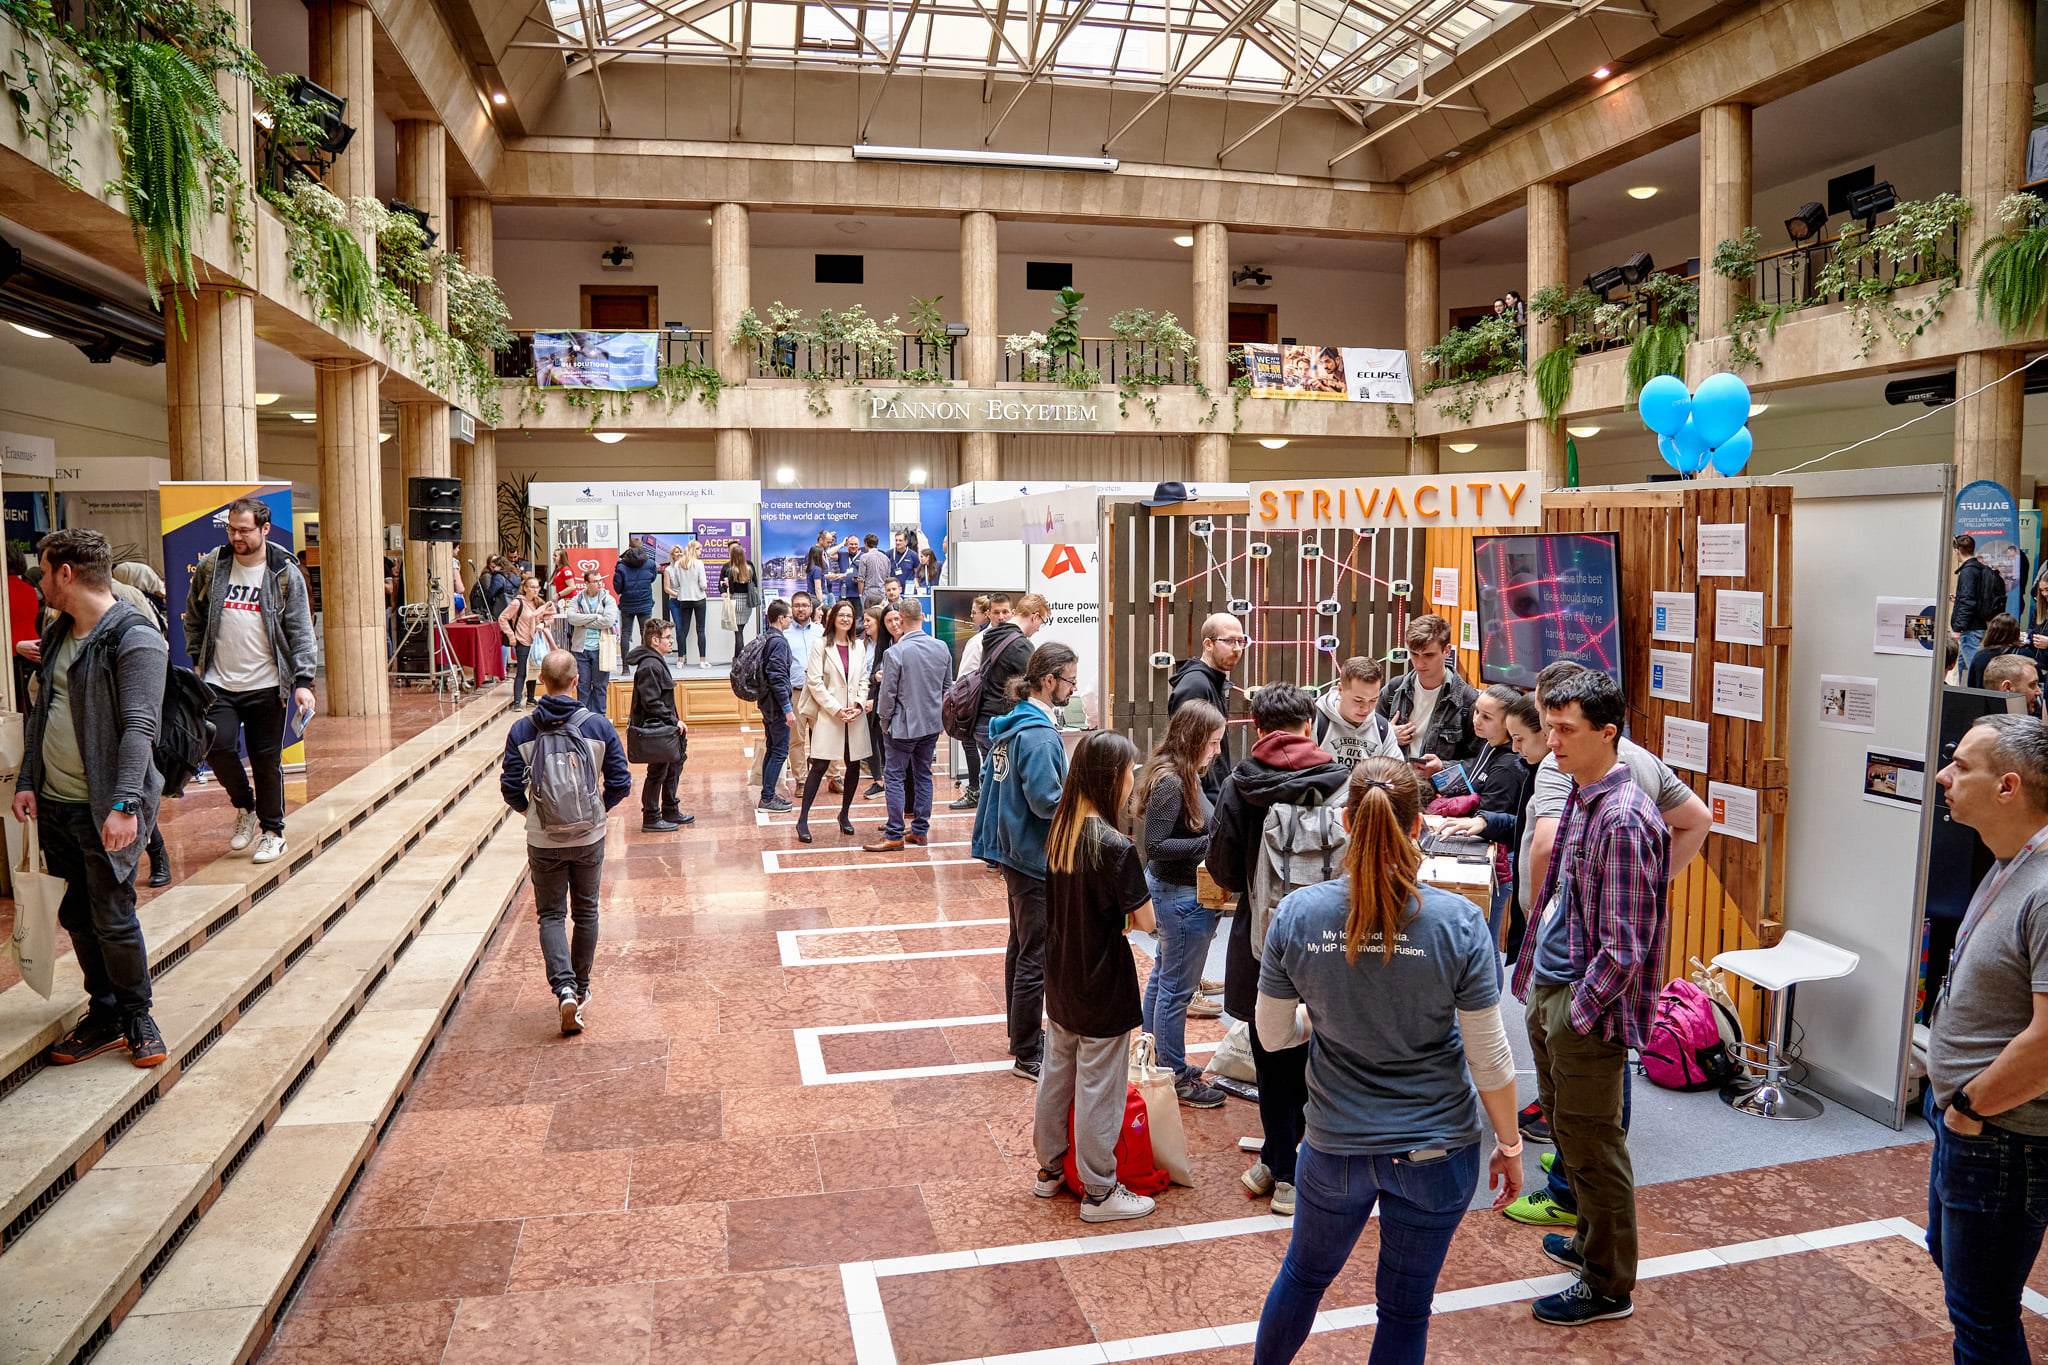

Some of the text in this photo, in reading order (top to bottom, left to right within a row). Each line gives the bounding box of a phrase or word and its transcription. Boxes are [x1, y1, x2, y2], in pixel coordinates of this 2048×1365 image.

[1256, 356, 1270, 364] WE
[871, 397, 1098, 421] PANNON EGYETEM
[5, 446, 37, 461] Erasmus+
[56, 469, 82, 479] ENT
[647, 489, 699, 498] Magyarország
[795, 501, 834, 510] technology
[1259, 482, 1526, 520] STRIVACITY
[779, 512, 791, 520] the
[793, 512, 812, 520] world
[828, 512, 858, 522] together
[1576, 573, 1586, 584] the
[1588, 573, 1602, 584] best
[249, 587, 262, 602] D
[1560, 592, 1580, 602] should
[1582, 593, 1603, 606] always
[1048, 602, 1074, 610] uture
[1590, 632, 1602, 643] and
[1346, 748, 1362, 757] are
[1322, 930, 1337, 941] My
[1393, 932, 1409, 941] kta.
[1307, 943, 1427, 957] My IdP is trivacit Fusion.
